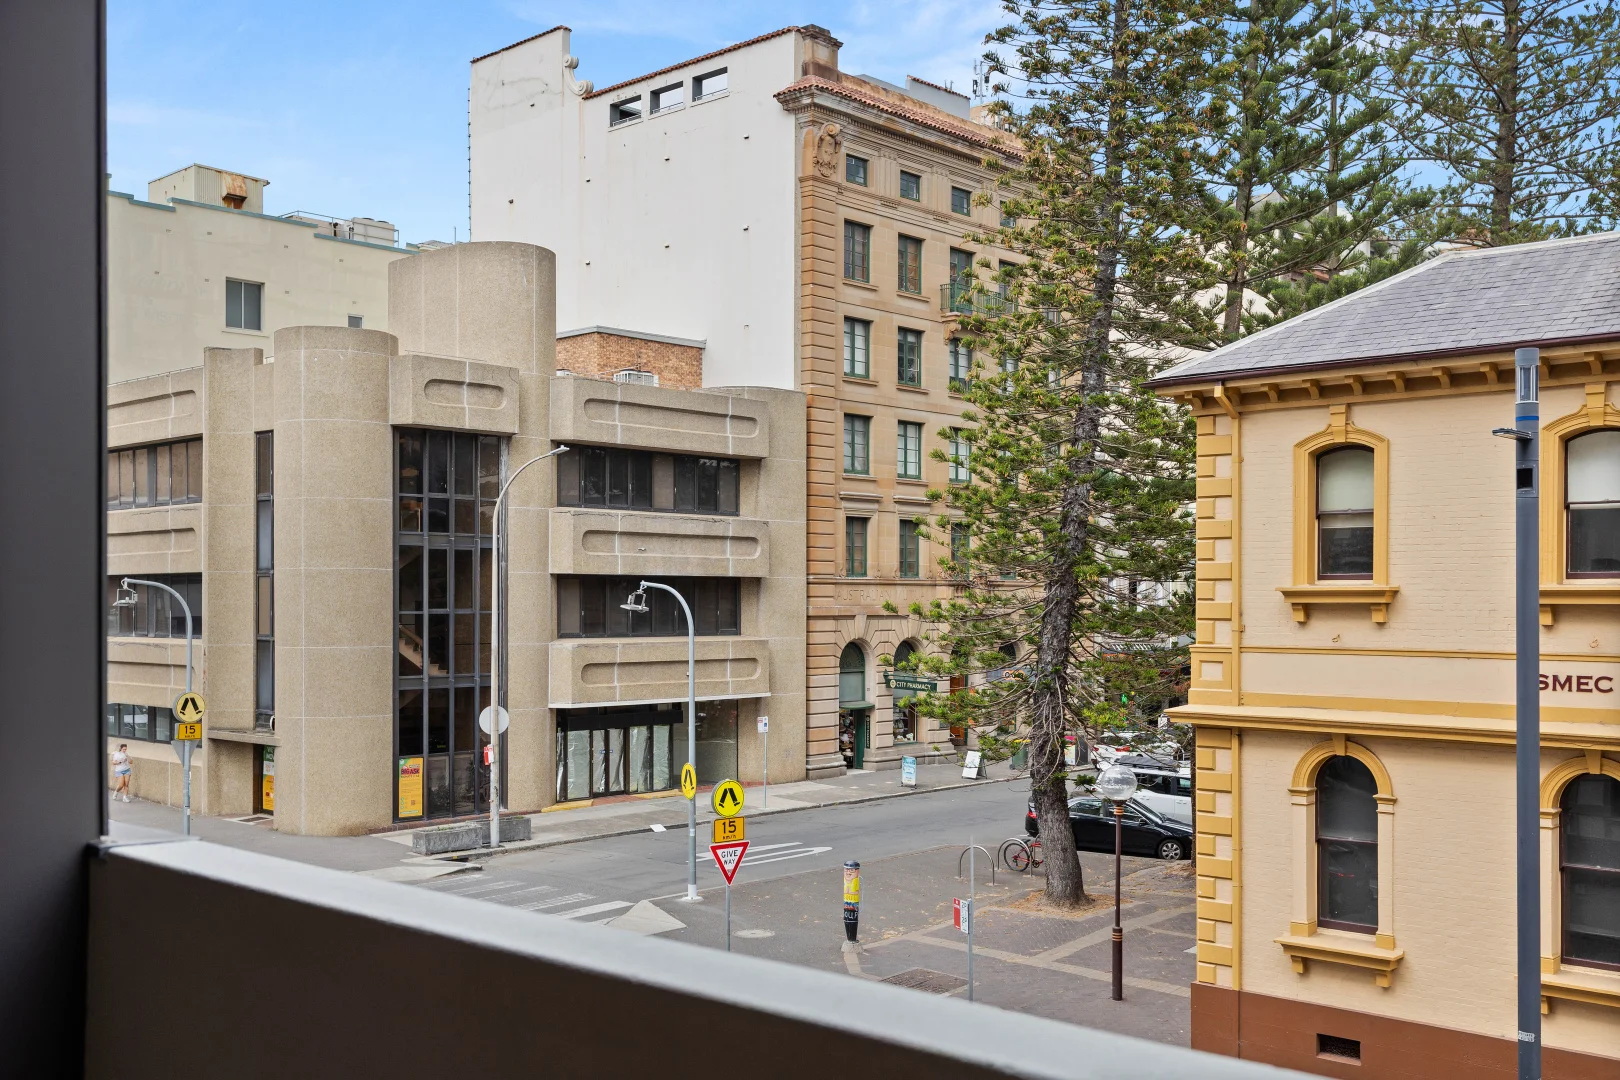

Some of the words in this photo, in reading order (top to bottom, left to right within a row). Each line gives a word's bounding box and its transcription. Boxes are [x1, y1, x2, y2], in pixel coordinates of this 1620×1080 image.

[835, 589, 891, 601] AUSTRALIAN
[907, 682, 932, 690] PHARMACY
[1539, 673, 1614, 694] SMEC
[185, 725, 196, 734] 15
[722, 820, 737, 834] 15
[721, 849, 739, 859] GIVE
